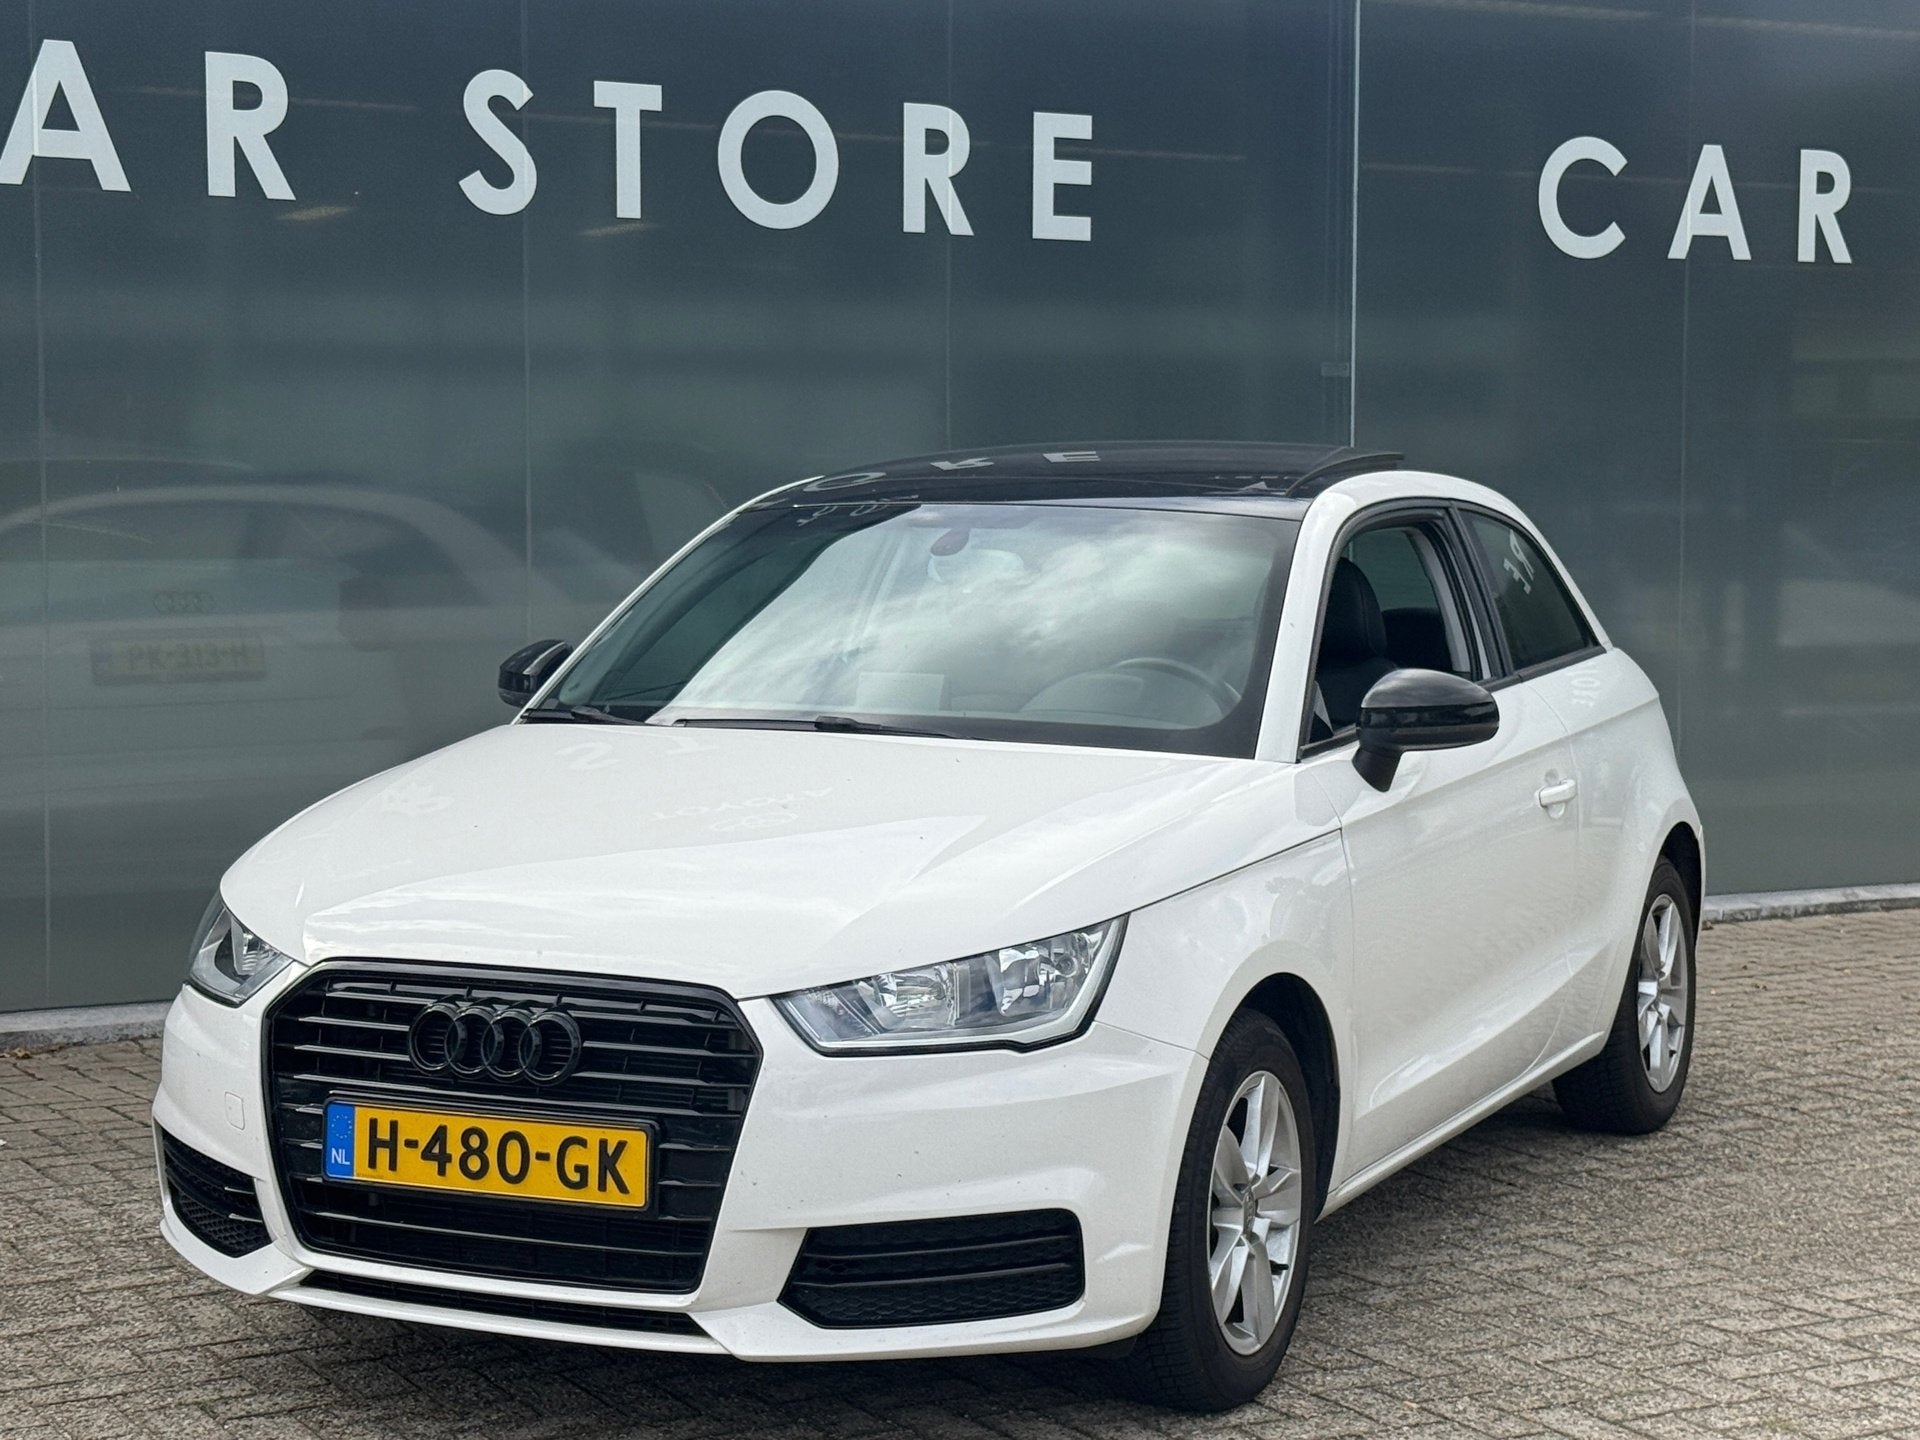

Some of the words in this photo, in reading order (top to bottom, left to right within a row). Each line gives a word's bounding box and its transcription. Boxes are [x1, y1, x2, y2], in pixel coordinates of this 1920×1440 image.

[459, 70, 1092, 241] STORE
[1539, 137, 1851, 263] CAR
[331, 1147, 350, 1165] NL
[367, 1117, 630, 1194] H-480-GK
